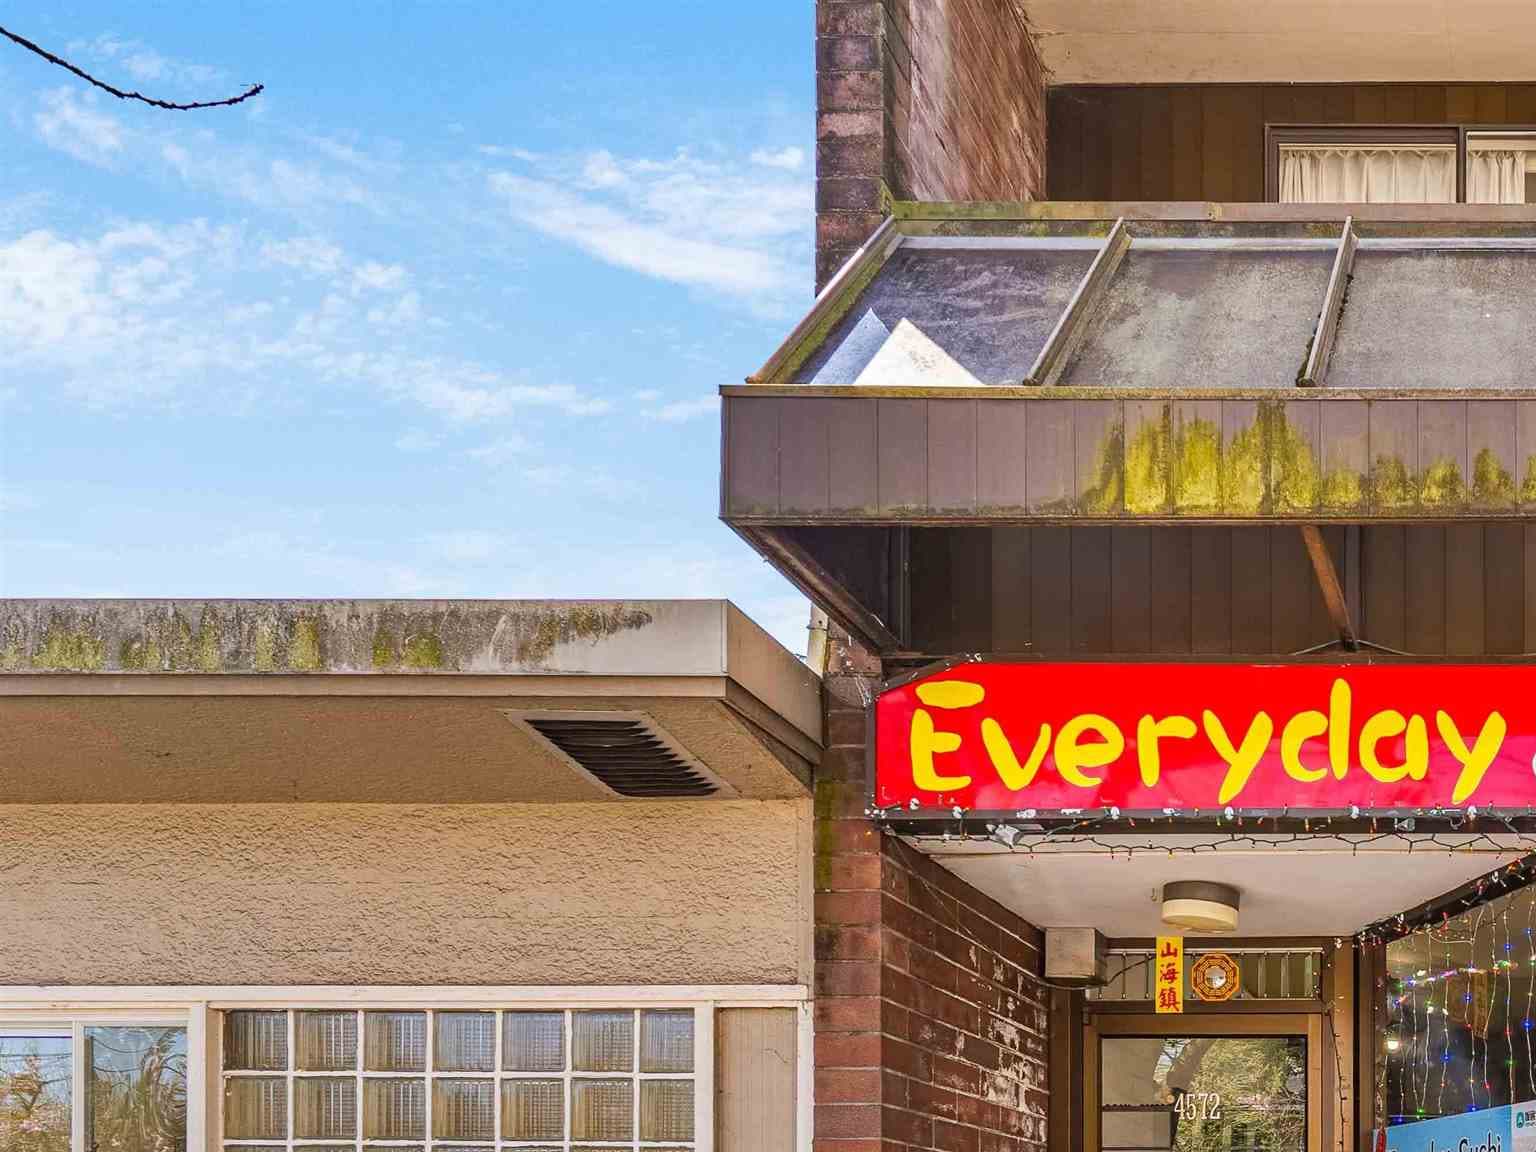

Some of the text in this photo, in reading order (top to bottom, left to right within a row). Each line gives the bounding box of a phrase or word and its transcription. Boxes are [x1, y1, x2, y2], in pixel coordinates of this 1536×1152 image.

[910, 678, 1507, 804] Everyday
[1160, 941, 1181, 1012] 山海鎮
[1174, 1093, 1221, 1120] 4572
